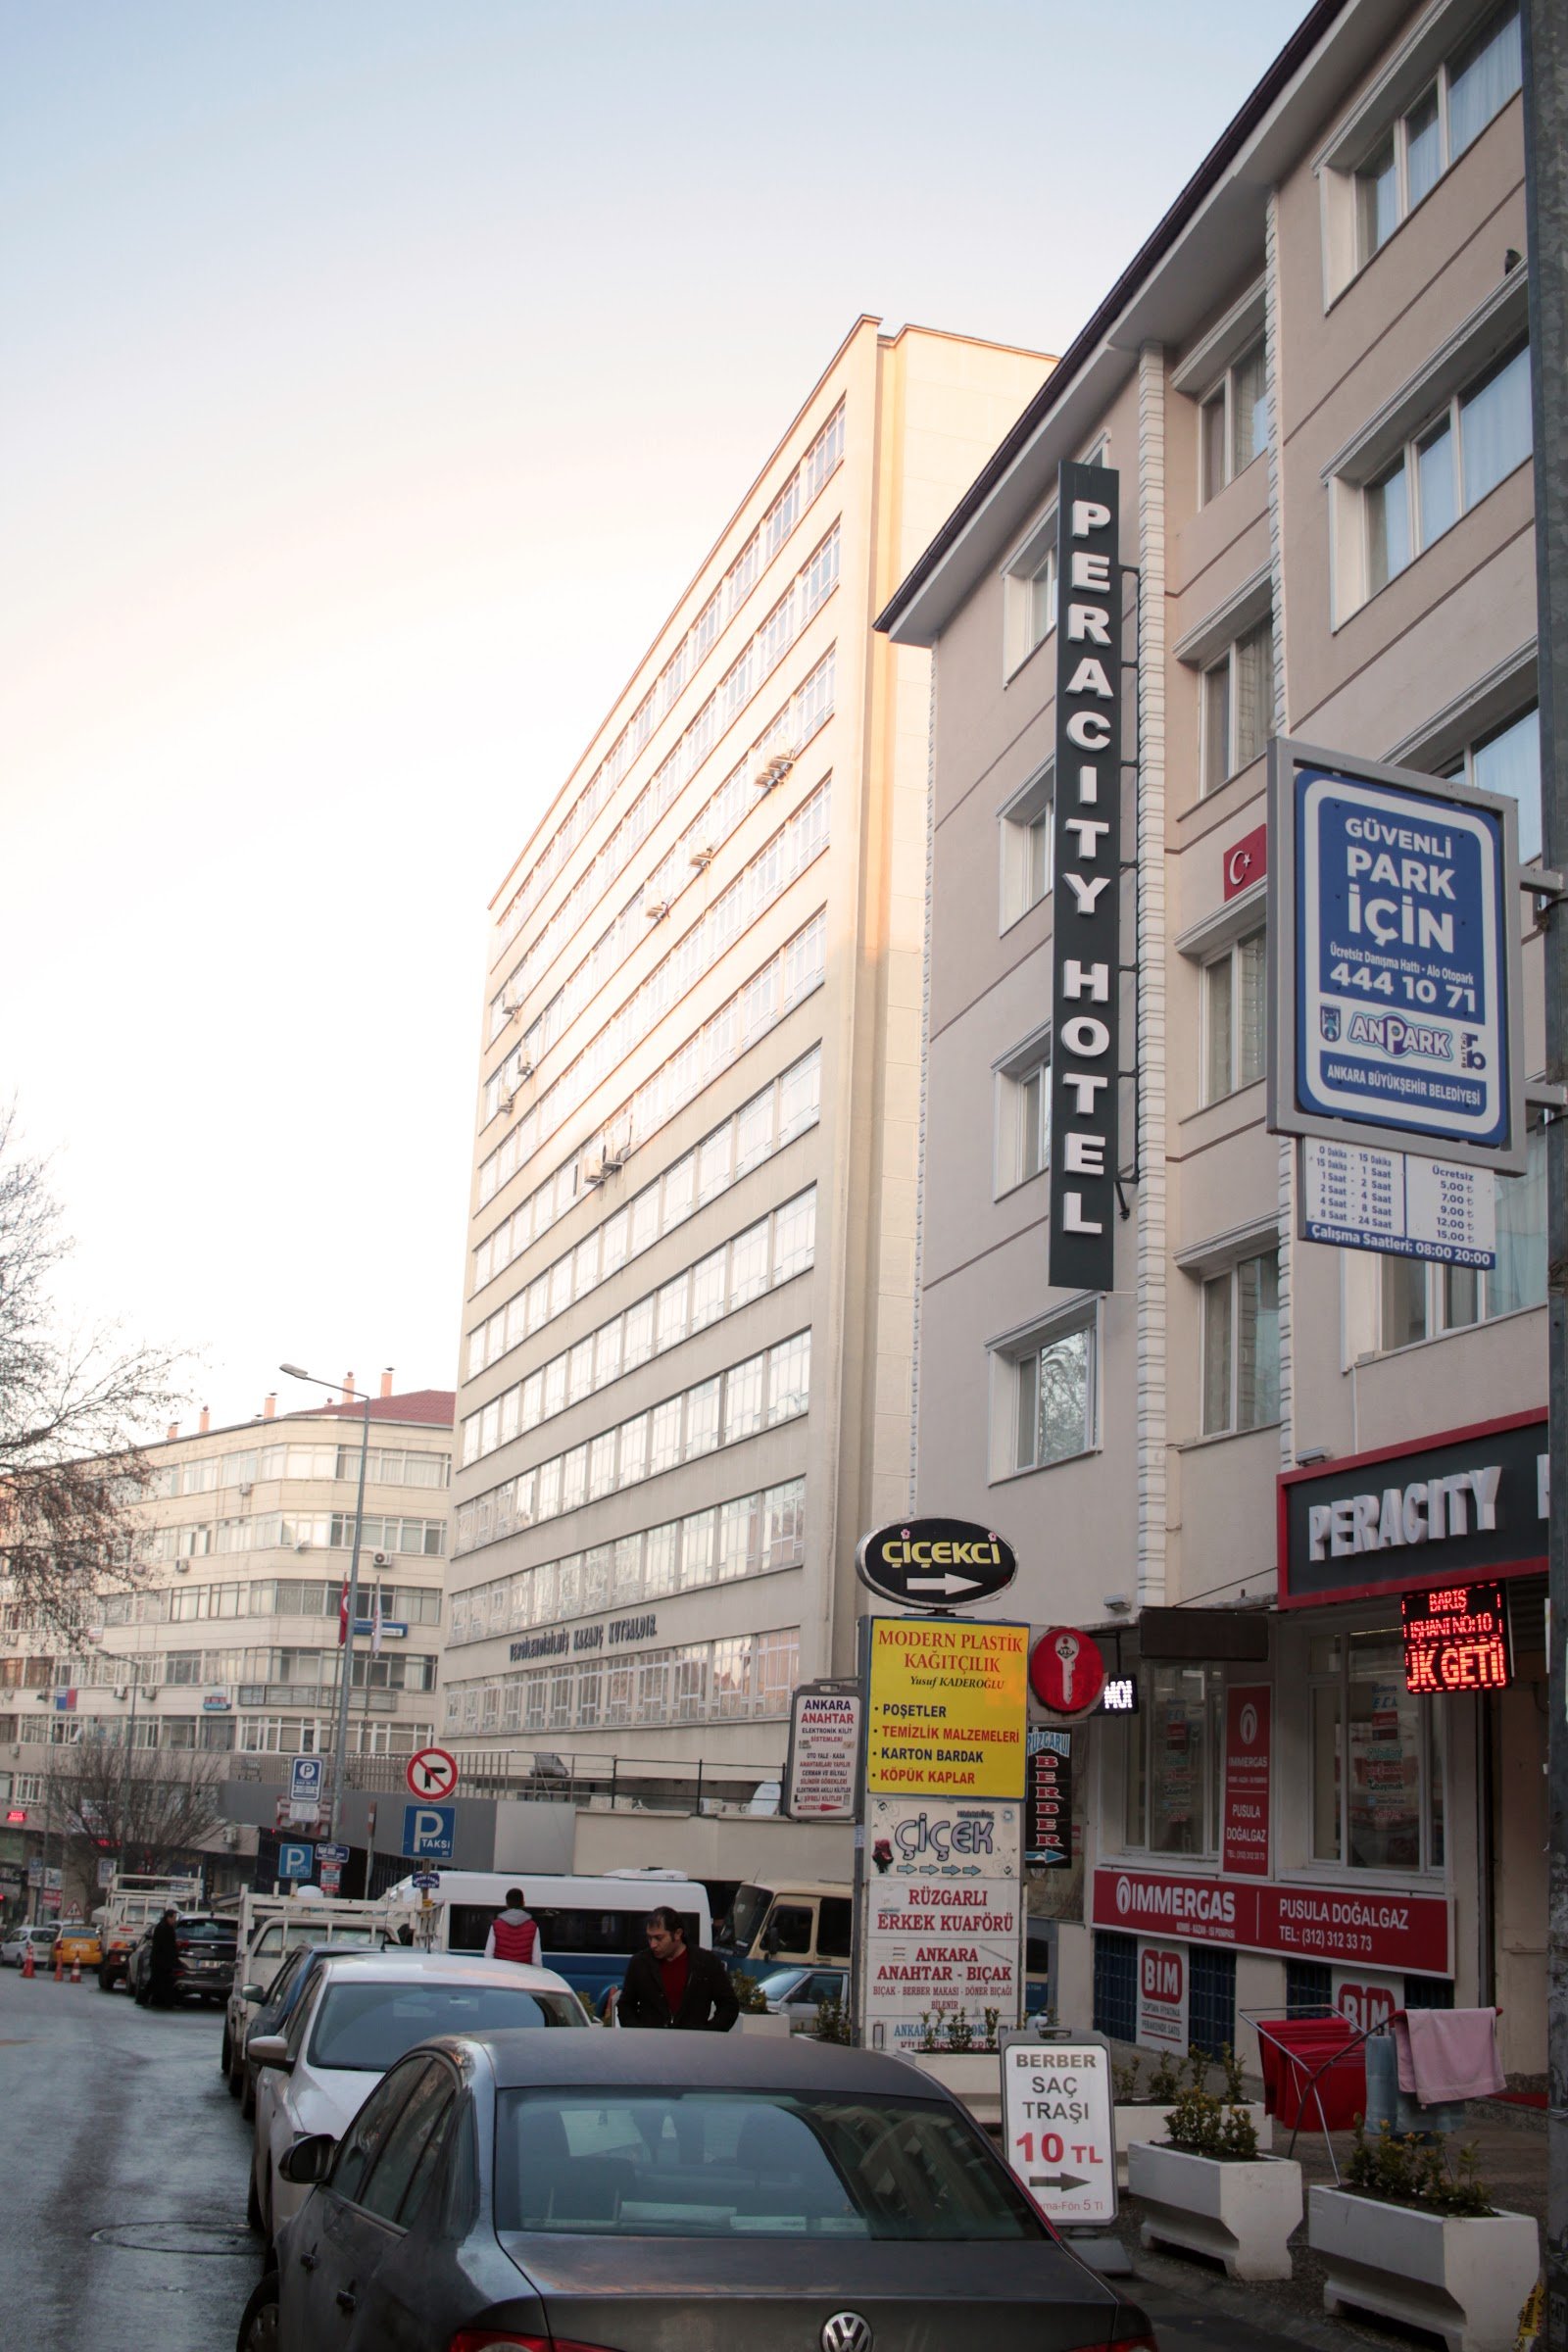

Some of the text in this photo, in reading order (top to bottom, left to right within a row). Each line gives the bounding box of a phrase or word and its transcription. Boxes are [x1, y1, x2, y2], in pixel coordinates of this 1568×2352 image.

[1346, 817, 1451, 859] GÜVENLİ
[1061, 500, 1113, 1235] PERACITY HOTEL
[1347, 846, 1456, 901] PARK
[1348, 883, 1453, 954] İÇİN
[1330, 942, 1363, 961] Ücretsiz
[1364, 952, 1398, 969] Danışma
[1427, 964, 1440, 977] Alo
[1443, 967, 1474, 986] Otopark
[1330, 962, 1475, 1012] 444 10 71
[1349, 1015, 1451, 1057] ANPARK
[1328, 1064, 1480, 1106] ANKARA BÜYÜKŞEHİR BELEDİYESİ
[1316, 1158, 1325, 1167] 15
[1372, 1168, 1392, 1179] Saat
[1359, 1152, 1368, 1161] 15
[1370, 1155, 1392, 1167] Dakika
[1328, 1173, 1347, 1184] Saat
[1372, 1180, 1392, 1192] Saat
[1432, 1164, 1474, 1182] Ücretsiz
[1328, 1185, 1347, 1197] Saat
[1361, 1191, 1367, 1200] 4
[1372, 1193, 1392, 1204] Saat
[1328, 1198, 1347, 1209] Saat
[1361, 1203, 1367, 1212] 8
[1372, 1205, 1392, 1217] Saat
[1329, 1210, 1348, 1222] Saat
[1358, 1216, 1370, 1225] 24
[1372, 1218, 1392, 1230] Saat
[1311, 1225, 1491, 1265] Çalışma Saatleri: 08:00 20:00
[1309, 1465, 1502, 1561] PERACITY
[573, 1624, 604, 1651] KAZANÇ
[878, 1630, 1023, 1652] MODERN PLASTİK
[905, 1649, 1001, 1675] KAĞITÇILIK
[910, 1675, 1004, 1690] Yusuf KADEROĞLU
[804, 1699, 852, 1711] ANKARA
[883, 1703, 947, 1719] POŞETLER
[801, 1713, 855, 1724] ANAHTAR
[882, 1723, 1019, 1743] TEMİZLİK MALZEMELERİ
[881, 1747, 984, 1763] KARTON BARDAK
[880, 1767, 975, 1785] KÖPÜK KAPLAR
[1036, 1755, 1065, 1847] BERBER
[1232, 1803, 1261, 1819] PUSULA
[895, 1813, 995, 1862] ÇİÇEK
[1227, 1826, 1266, 1843] DOĞALGAZ
[908, 1886, 988, 1907] RÜZGARLI
[1131, 1882, 1236, 1924] IMMERGAS
[877, 1912, 1013, 1932] ERKEK KUAFÖRÜ
[1279, 1898, 1409, 1931] PUSULA DOĞALGAZ
[1279, 1925, 1372, 1952] TEL: (312) 312 33 73
[915, 1947, 978, 1962] ANKARA
[877, 1965, 1011, 1984] ANAHTAR BIÇAK
[873, 1985, 896, 1997] BIÇAK
[903, 1986, 931, 1996] BERBER
[933, 1986, 959, 1996] MAKASI
[965, 1984, 988, 1996] DÖNER
[990, 1984, 1012, 1997] BIÇAĞI
[931, 1999, 959, 2010] BİLENİR
[1015, 2053, 1097, 2068] BERBER
[1032, 2076, 1078, 2099] SAÇ
[1022, 2101, 1089, 2125] TRAŞI
[1016, 2132, 1103, 2164] 10 TL
[1083, 2199, 1091, 2211] 5
